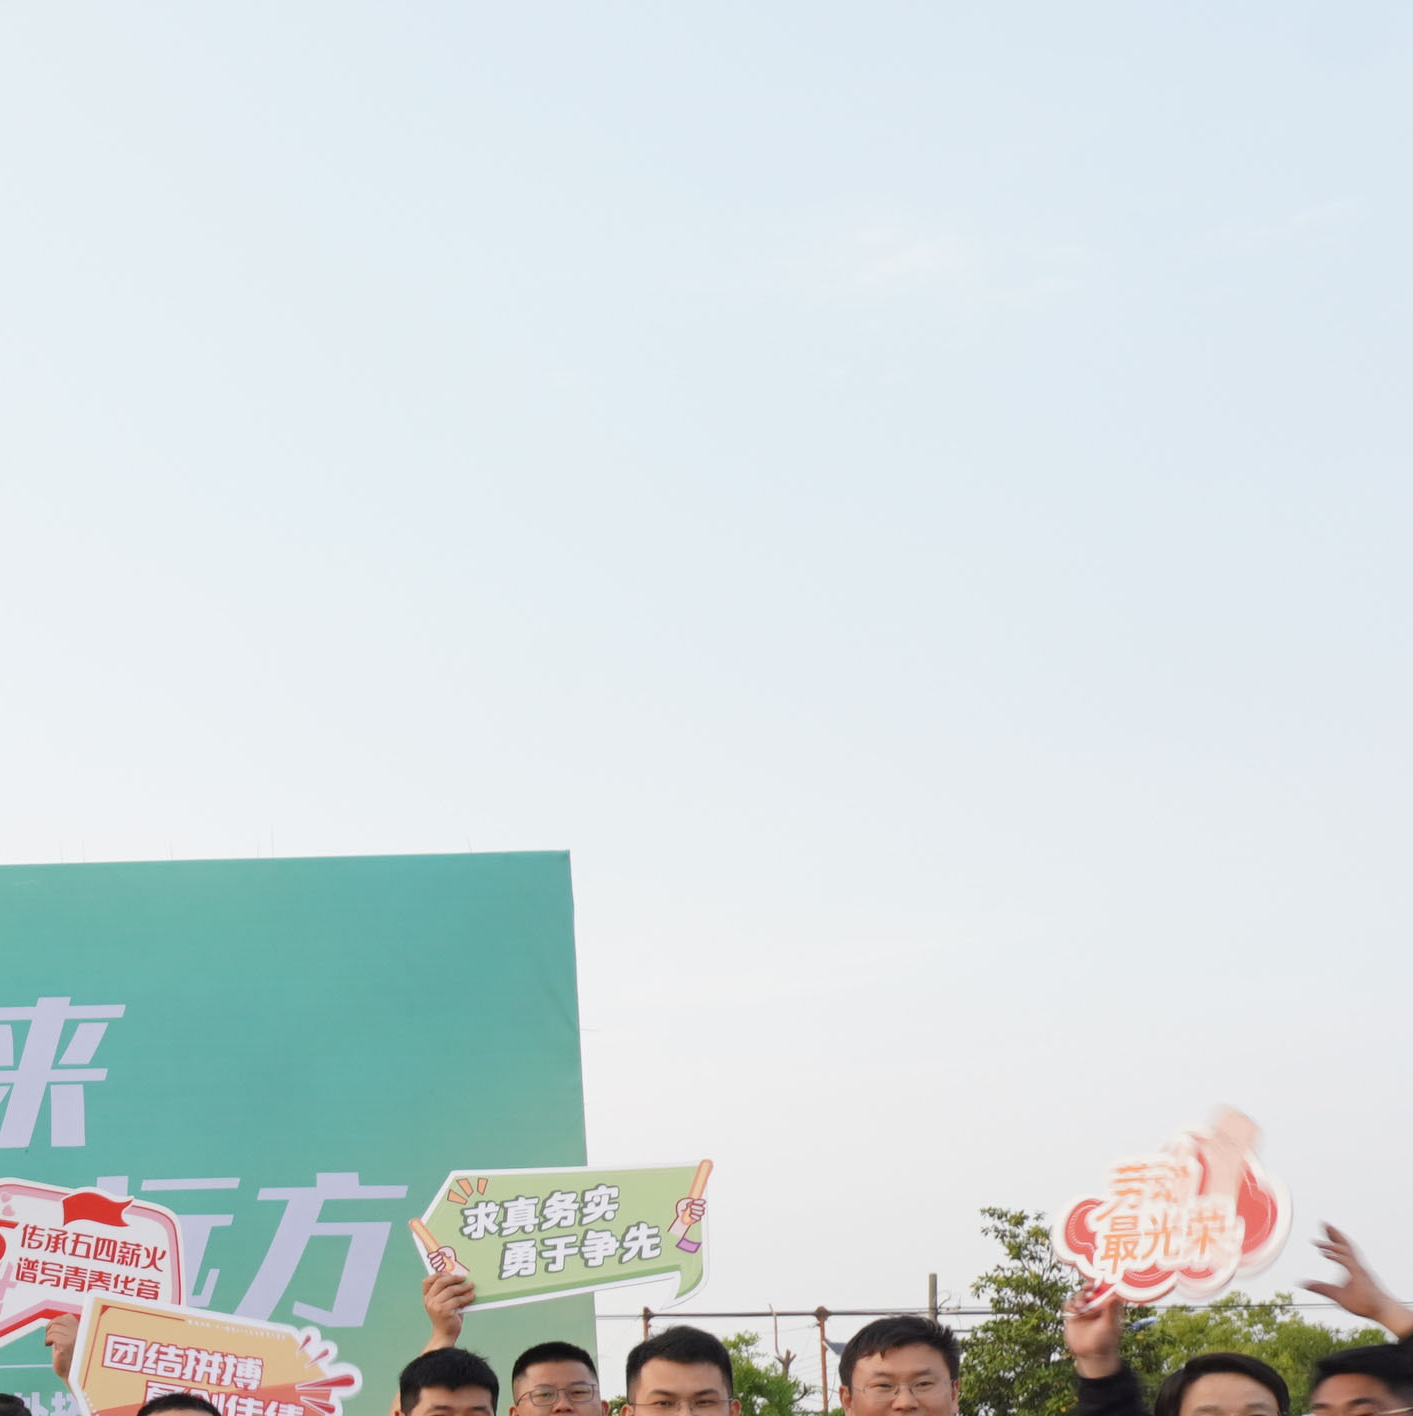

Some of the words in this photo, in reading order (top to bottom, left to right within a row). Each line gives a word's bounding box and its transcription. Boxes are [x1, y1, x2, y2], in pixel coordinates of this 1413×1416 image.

[462, 1184, 620, 1240] 求真务实
[20, 1224, 167, 1272] 传承五四薪火
[500, 1222, 661, 1280] 勇于争先
[102, 1334, 263, 1390] 团结拼搏
